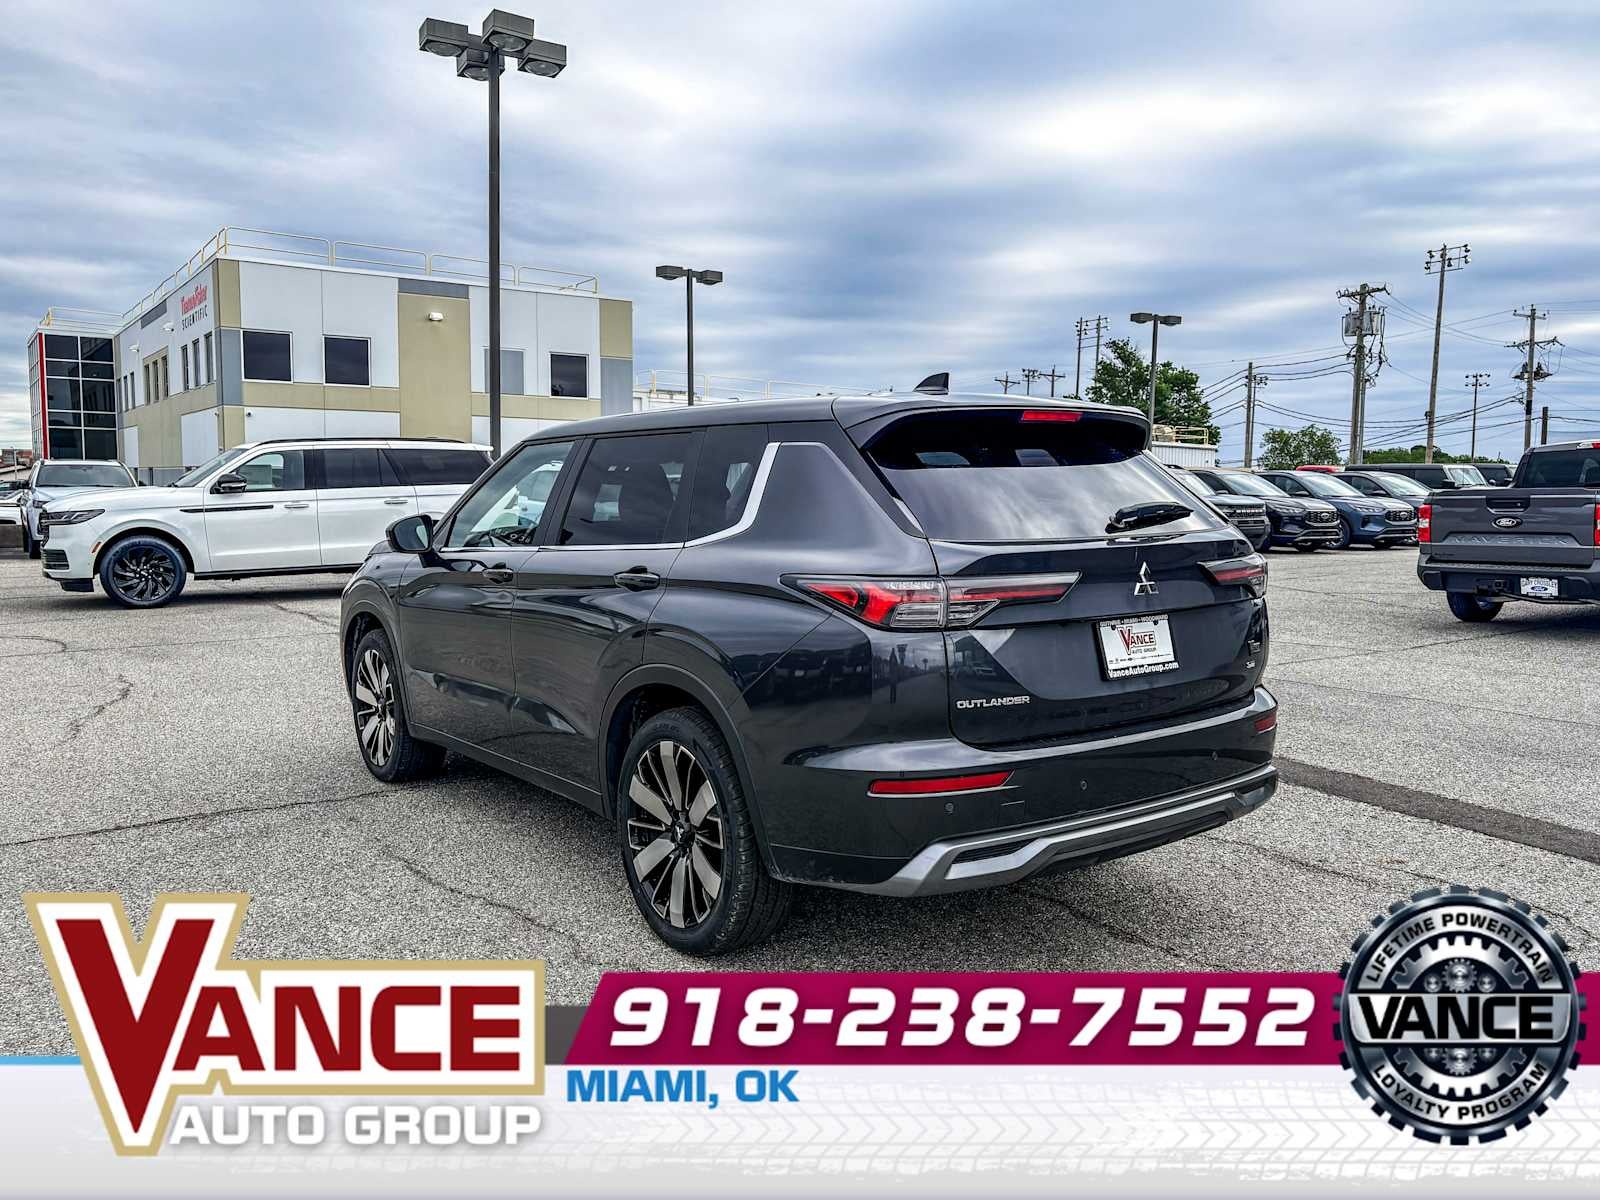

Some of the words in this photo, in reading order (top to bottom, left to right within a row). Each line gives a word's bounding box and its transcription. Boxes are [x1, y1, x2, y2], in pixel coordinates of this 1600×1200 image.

[182, 305, 208, 330] SCIENTIFIC
[1119, 628, 1155, 652] VANCE
[1108, 661, 1179, 678] VanceAutoGroup.com
[956, 695, 1031, 709] OUTLANDER
